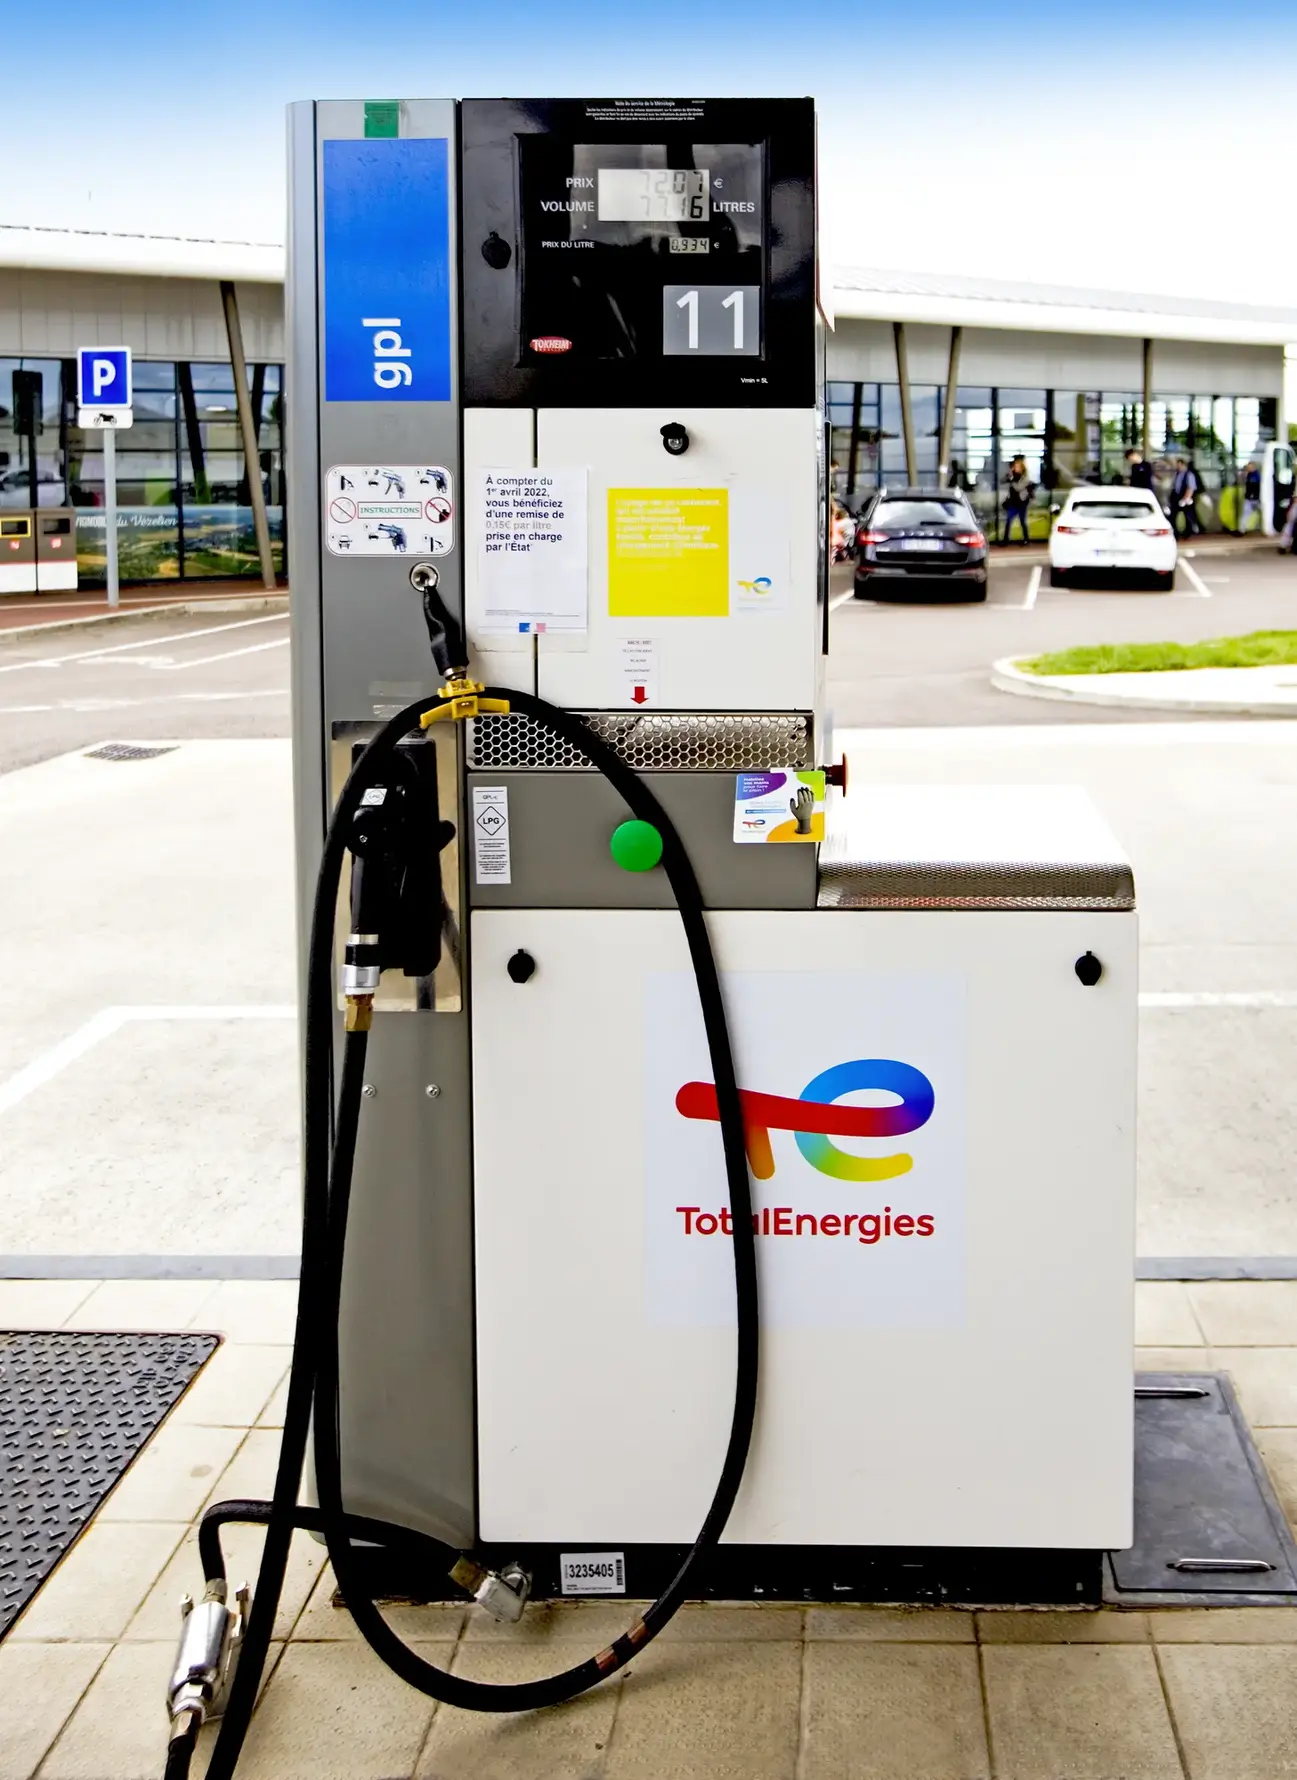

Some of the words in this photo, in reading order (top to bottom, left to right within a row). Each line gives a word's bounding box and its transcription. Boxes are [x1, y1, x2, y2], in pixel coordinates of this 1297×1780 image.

[566, 178, 595, 188] PRIX
[713, 178, 724, 189] €
[540, 201, 595, 212] VOLUME
[712, 202, 756, 213] LITRES
[542, 241, 559, 249] PRIX
[561, 241, 573, 249] DU
[574, 241, 595, 249] LITRE
[532, 339, 570, 351] TOKHEIM
[361, 318, 412, 389] gpl
[93, 359, 117, 397] P
[486, 474, 493, 485] À
[496, 478, 538, 487] compter
[540, 477, 553, 486] du
[500, 488, 521, 496] avril
[524, 488, 550, 497] 2022,
[513, 499, 563, 508] bénéficiez
[360, 506, 420, 514] INSTRUCTIONS
[486, 510, 513, 518] d'une
[516, 510, 549, 518] remise
[552, 510, 565, 518] de
[513, 522, 530, 531] par
[533, 521, 552, 529] litre
[486, 532, 511, 542] prise
[528, 532, 563, 543] charge
[486, 544, 503, 553] par
[569, 563, 614, 579] 3235405
[482, 817, 500, 825] LPG
[675, 1206, 935, 1244] TotlEnergies
